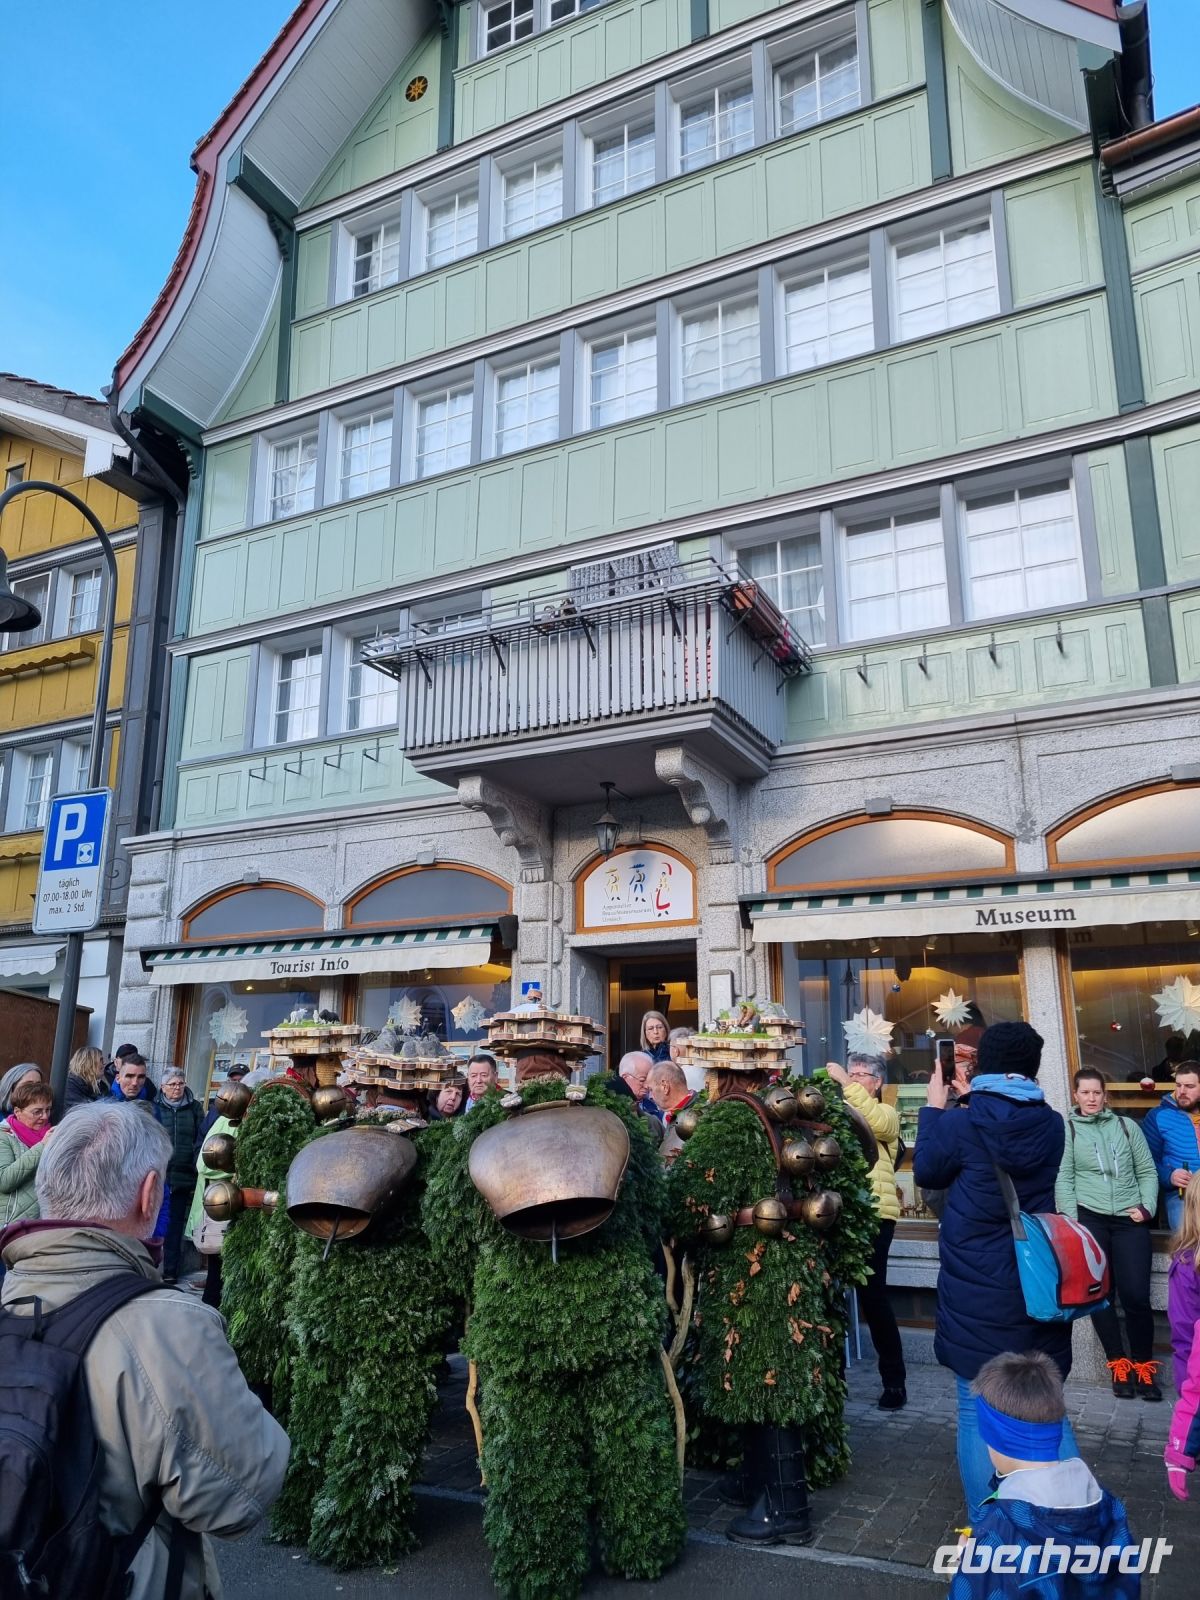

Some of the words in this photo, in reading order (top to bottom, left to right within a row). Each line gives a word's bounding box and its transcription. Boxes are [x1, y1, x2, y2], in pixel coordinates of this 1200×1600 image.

[53, 802, 88, 862] P
[58, 878, 80, 890] täglich
[42, 890, 79, 903] 07.00-18.00
[81, 888, 93, 898] Uhr
[48, 906, 65, 915] max.
[66, 904, 71, 913] 2
[73, 902, 86, 913] Std.
[975, 907, 1077, 926] Museum
[270, 959, 315, 975] Tourist
[319, 956, 350, 971] Info
